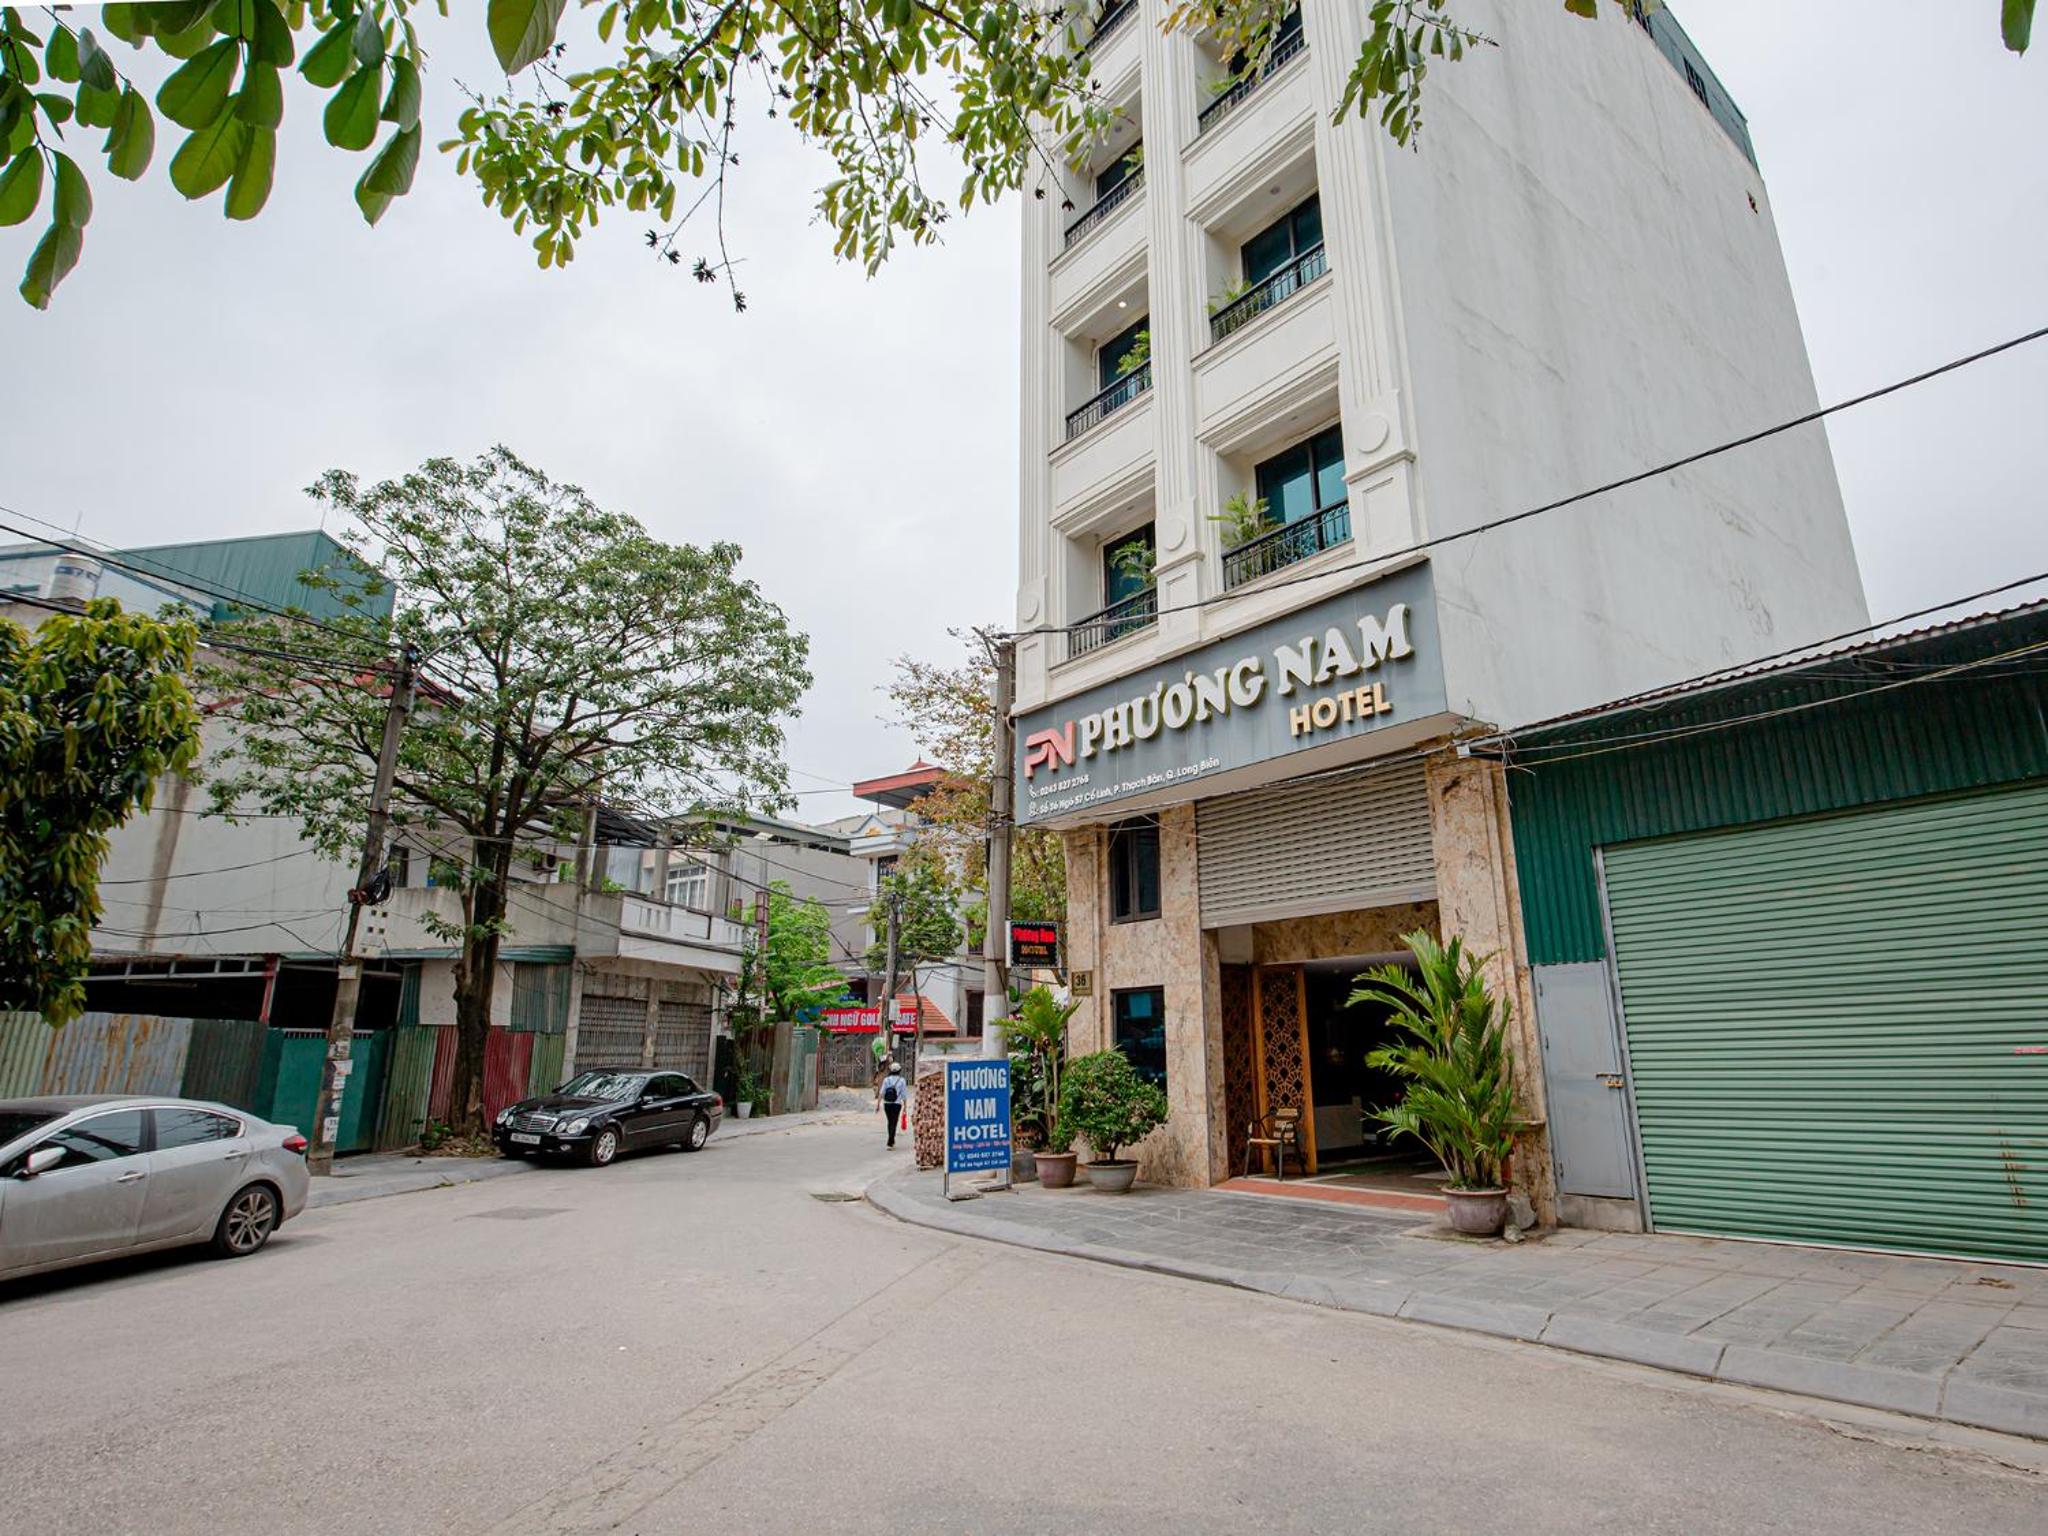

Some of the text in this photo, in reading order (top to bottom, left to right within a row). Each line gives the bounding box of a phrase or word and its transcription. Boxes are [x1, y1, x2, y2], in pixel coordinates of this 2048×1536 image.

[1080, 603, 1413, 758] PHƯƠNG NAM
[1290, 682, 1393, 737] HOTEL
[1177, 765, 1198, 776] Long
[951, 1067, 1007, 1091] PHƯƠNG
[964, 1098, 996, 1120] NAM
[953, 1123, 1007, 1140] HOTEL
